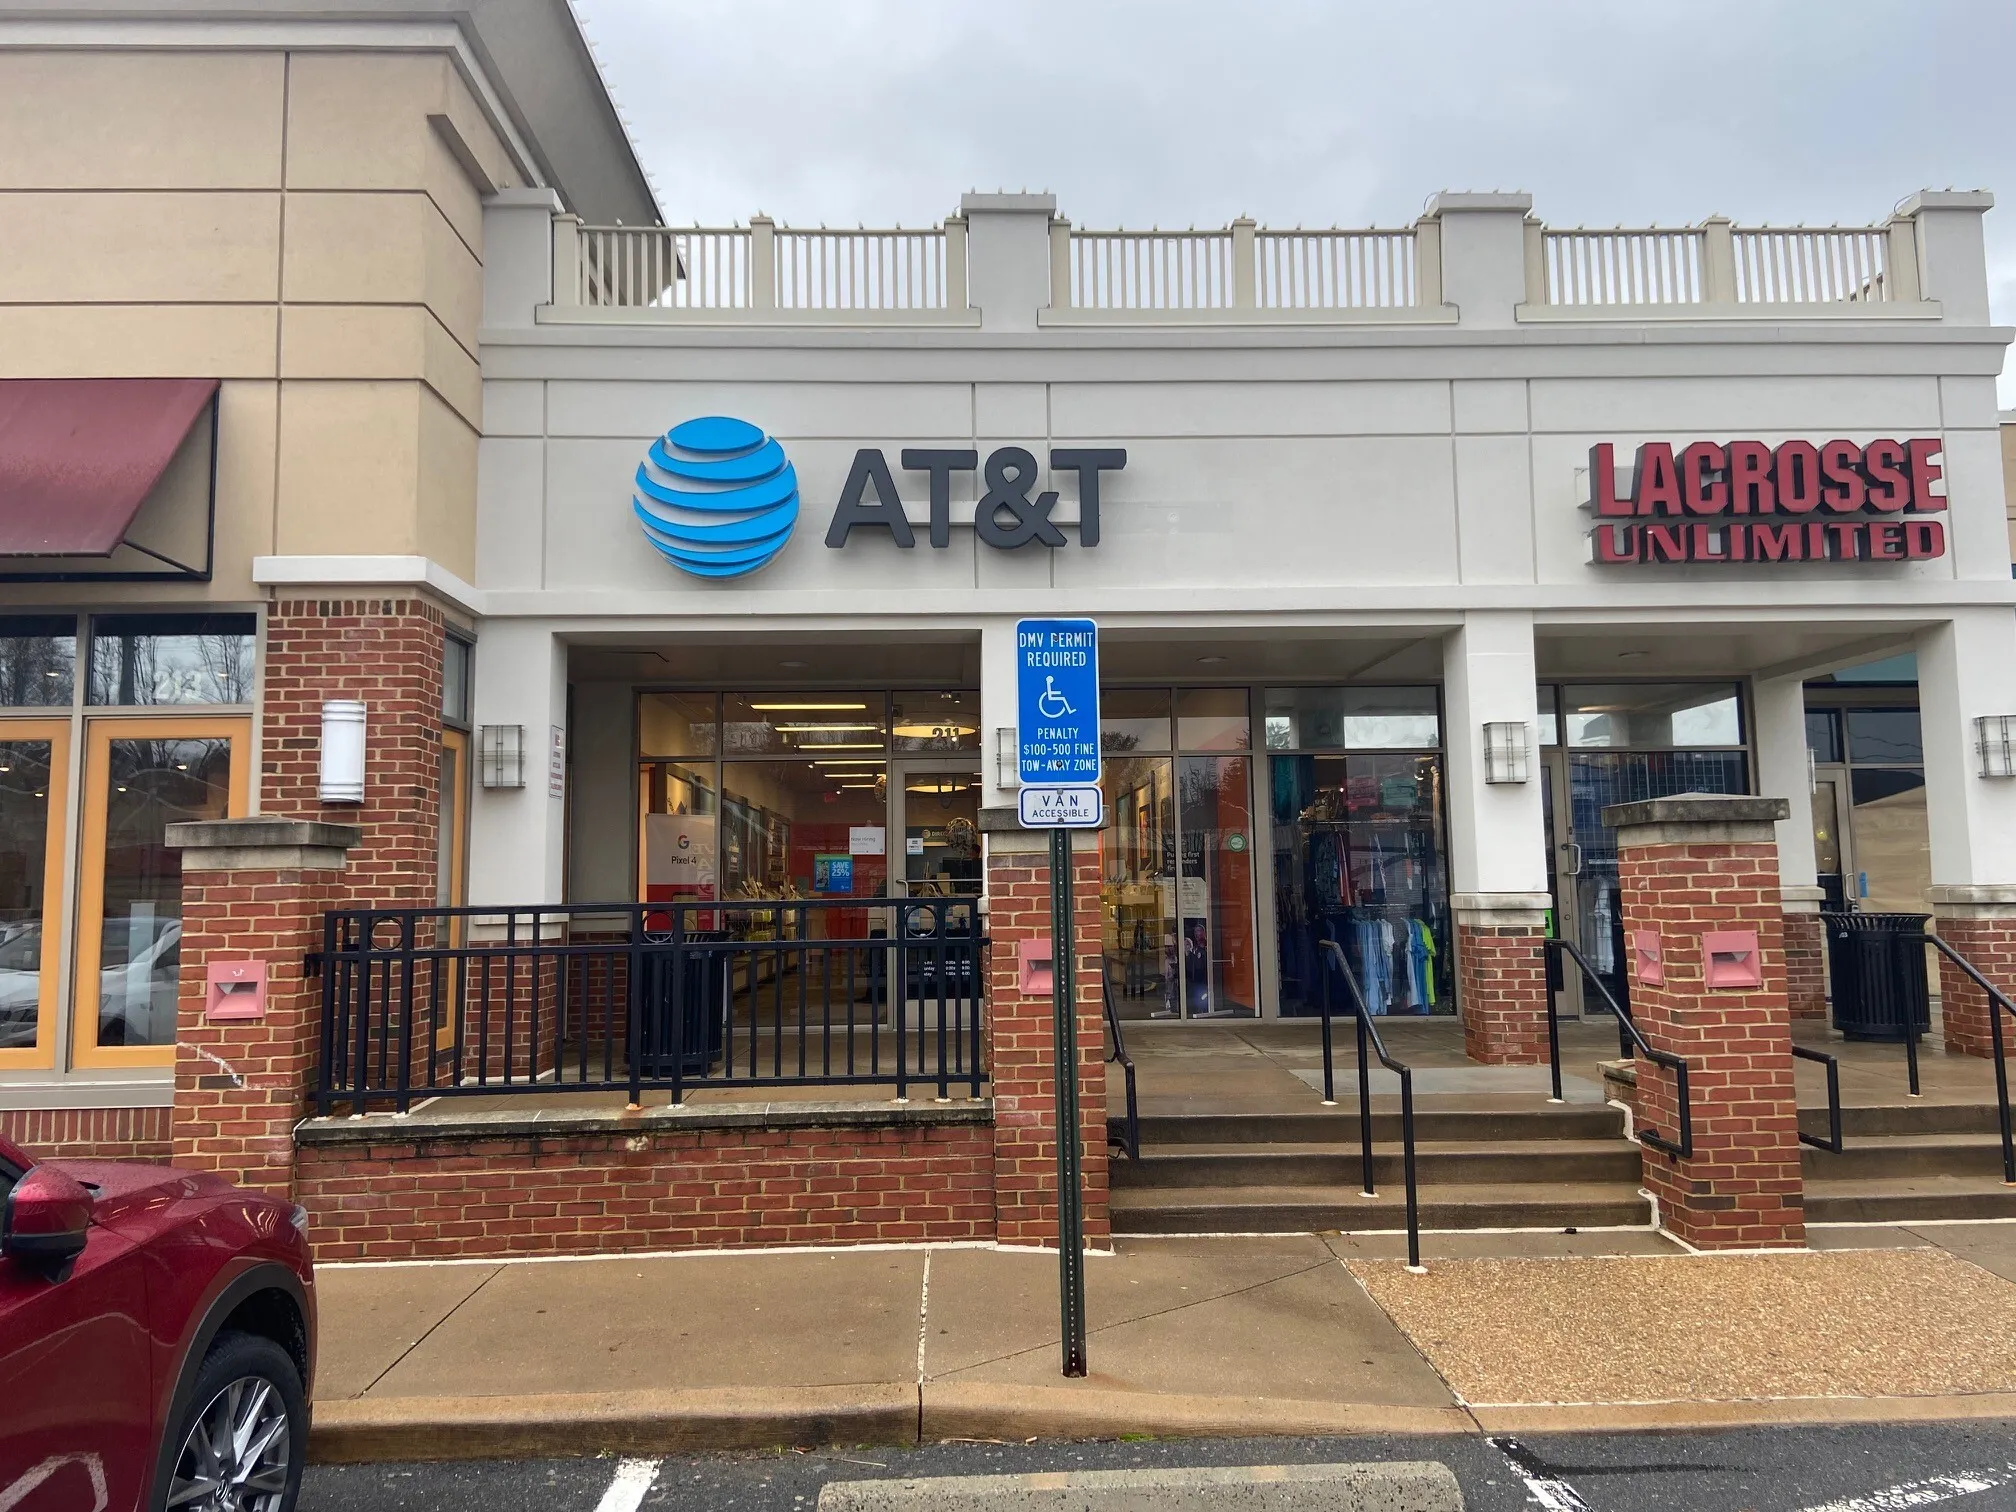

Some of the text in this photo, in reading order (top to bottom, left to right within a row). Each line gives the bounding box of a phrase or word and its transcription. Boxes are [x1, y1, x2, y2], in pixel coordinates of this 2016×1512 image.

[1590, 438, 1947, 518] LACROSSE
[825, 446, 1127, 549] AT&T
[1592, 521, 1946, 564] UNLIMITED
[1019, 632, 1093, 647] DMV PERMIT
[1027, 652, 1087, 667] REQUIRED
[152, 670, 202, 699] 213
[932, 727, 960, 750] 211
[1037, 727, 1079, 740] PENALTY
[1023, 743, 1095, 756] $100-500 FINE
[1021, 759, 1097, 772] TOW-AWAY ZONE
[1042, 795, 1078, 807] VAN
[1032, 809, 1089, 818] ACCESSIBLE
[677, 834, 690, 850] G
[671, 855, 697, 865] Pixel 4
[832, 861, 849, 869] SAVE
[831, 869, 850, 877] 25%
